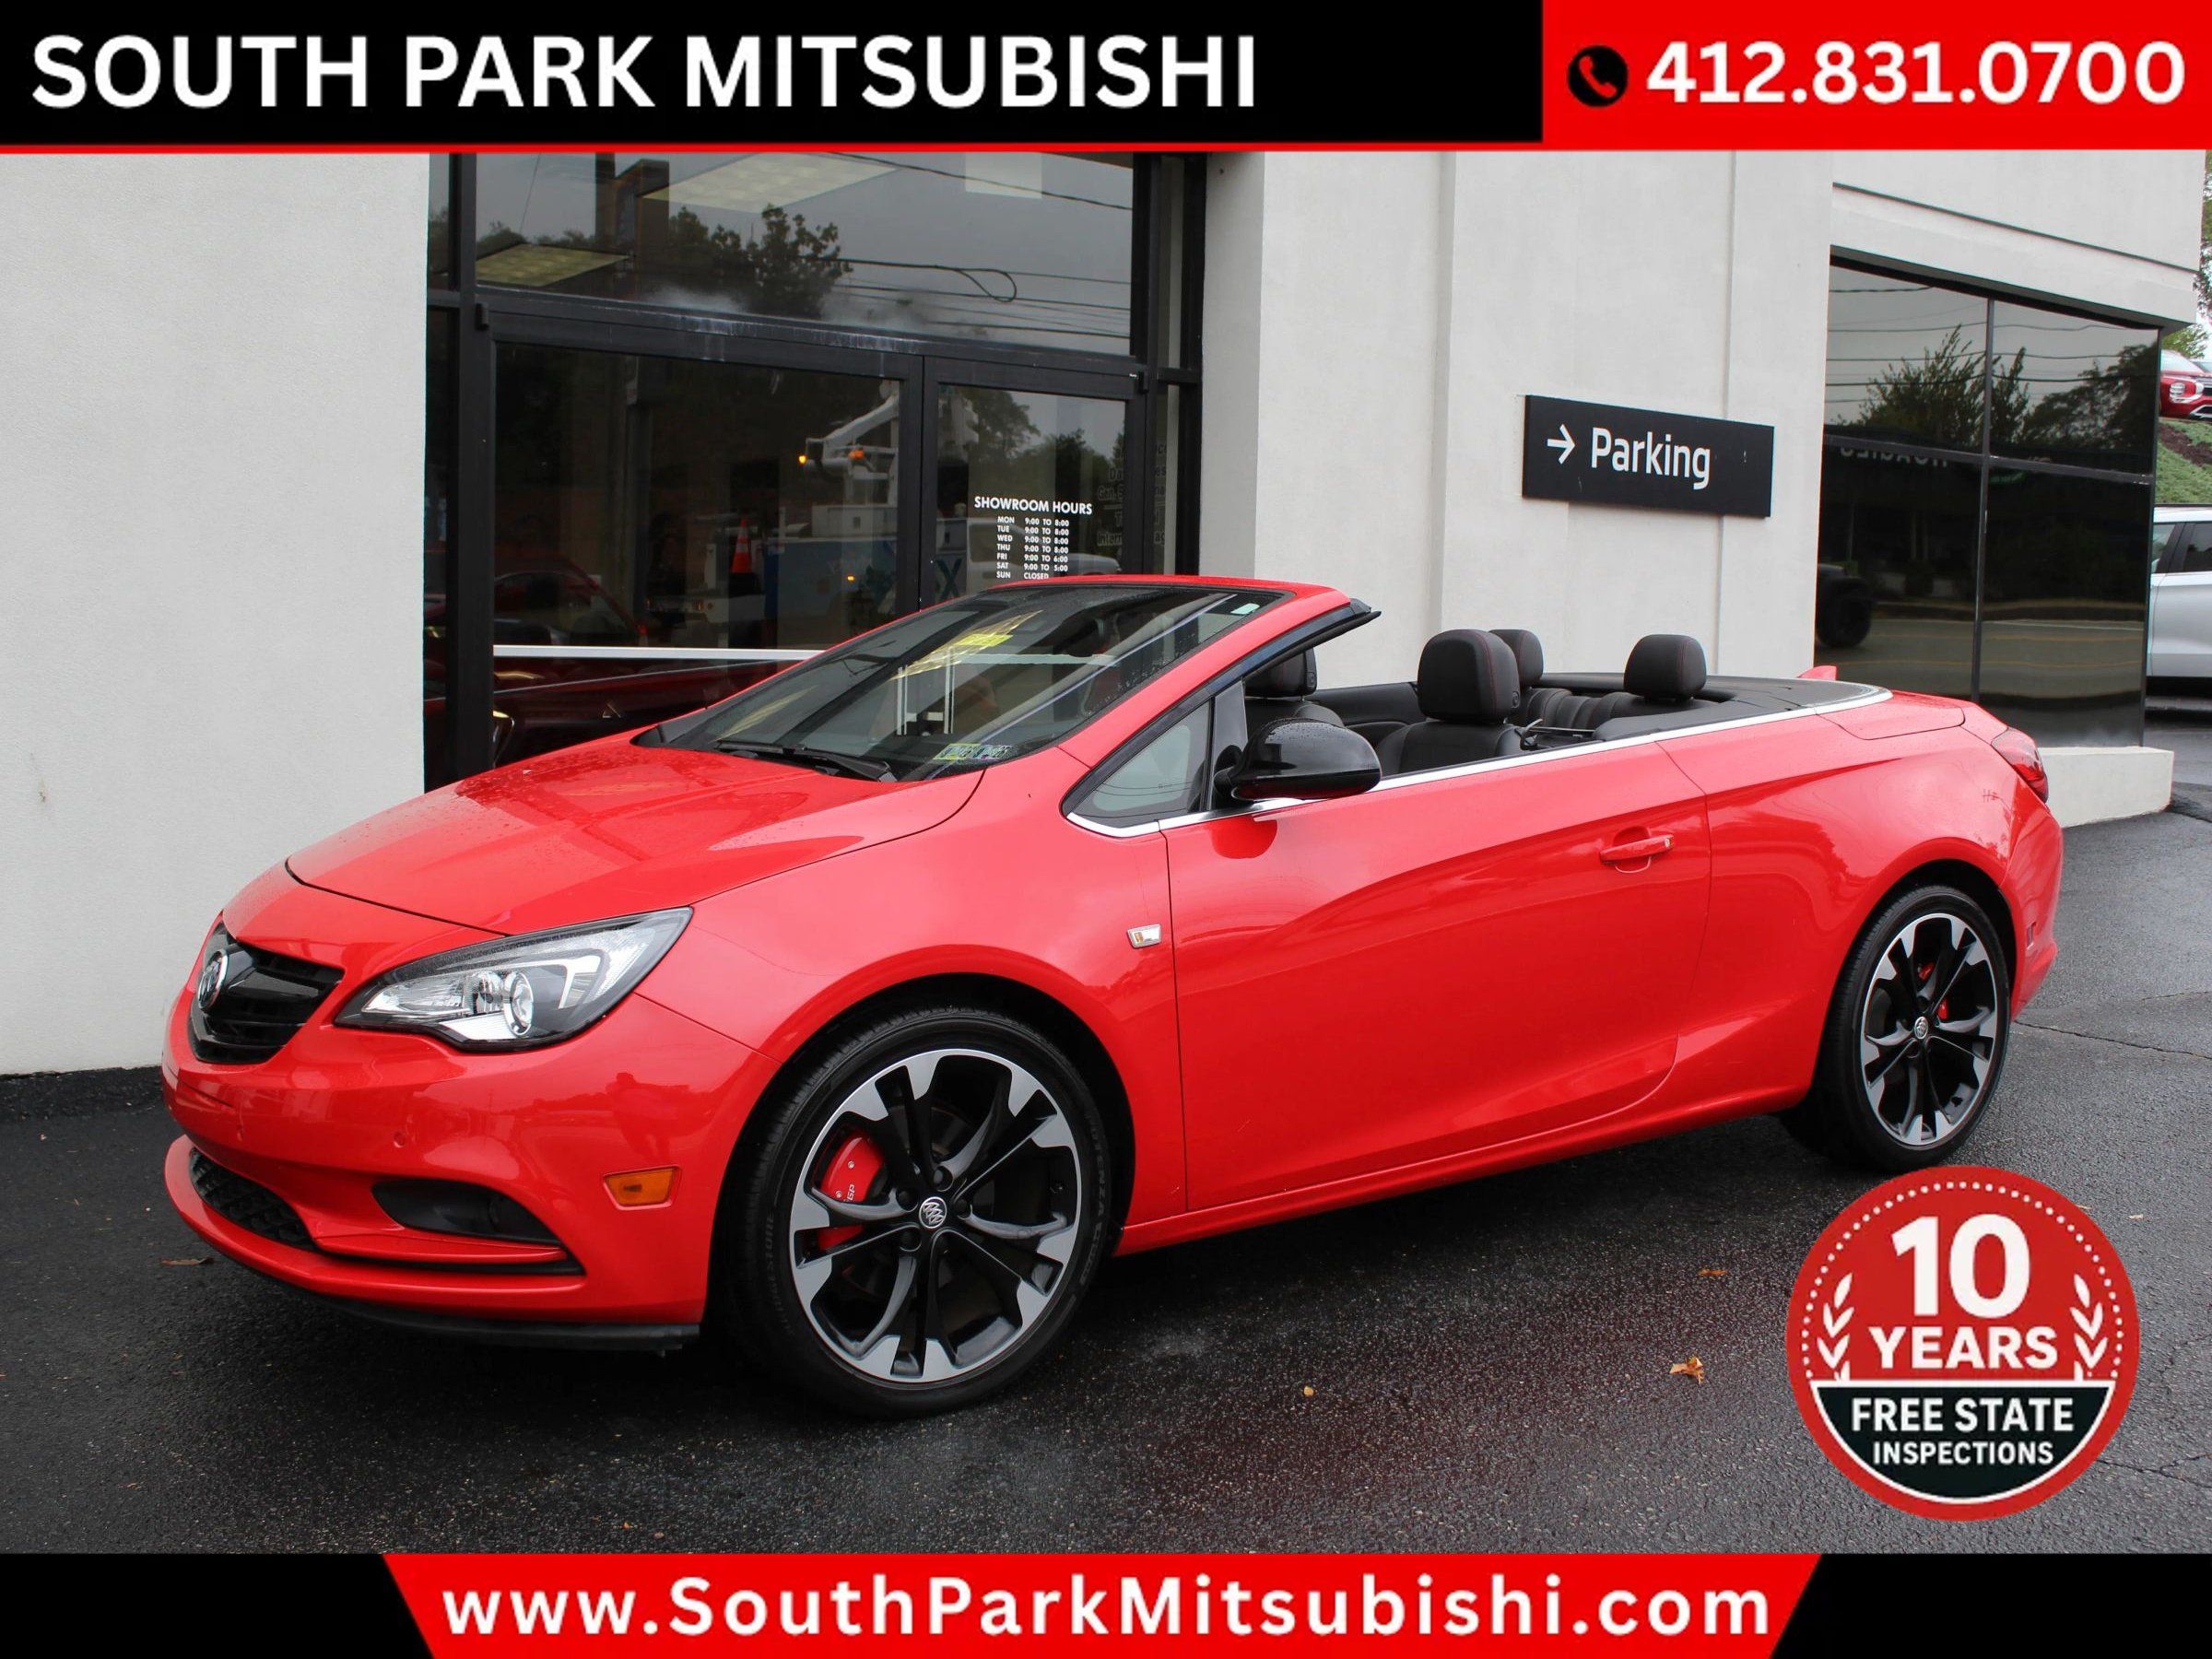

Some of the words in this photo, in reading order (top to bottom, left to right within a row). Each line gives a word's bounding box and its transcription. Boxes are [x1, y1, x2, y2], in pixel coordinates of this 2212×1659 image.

[1591, 427, 1711, 490] Parking
[974, 496, 1050, 512] SHOWROOM
[1053, 501, 1092, 515] HOURS
[1025, 517, 1040, 525] 9:00
[1042, 518, 1052, 526] TO
[1054, 519, 1069, 527] 8:00
[1024, 526, 1039, 535] 9:00
[1041, 527, 1052, 535] TO
[1054, 528, 1069, 536] 8:00
[1024, 535, 1039, 544] 9:00
[1024, 545, 1039, 553] 9:00
[1024, 554, 1039, 562] 9:00
[1053, 564, 1068, 572] 5:00
